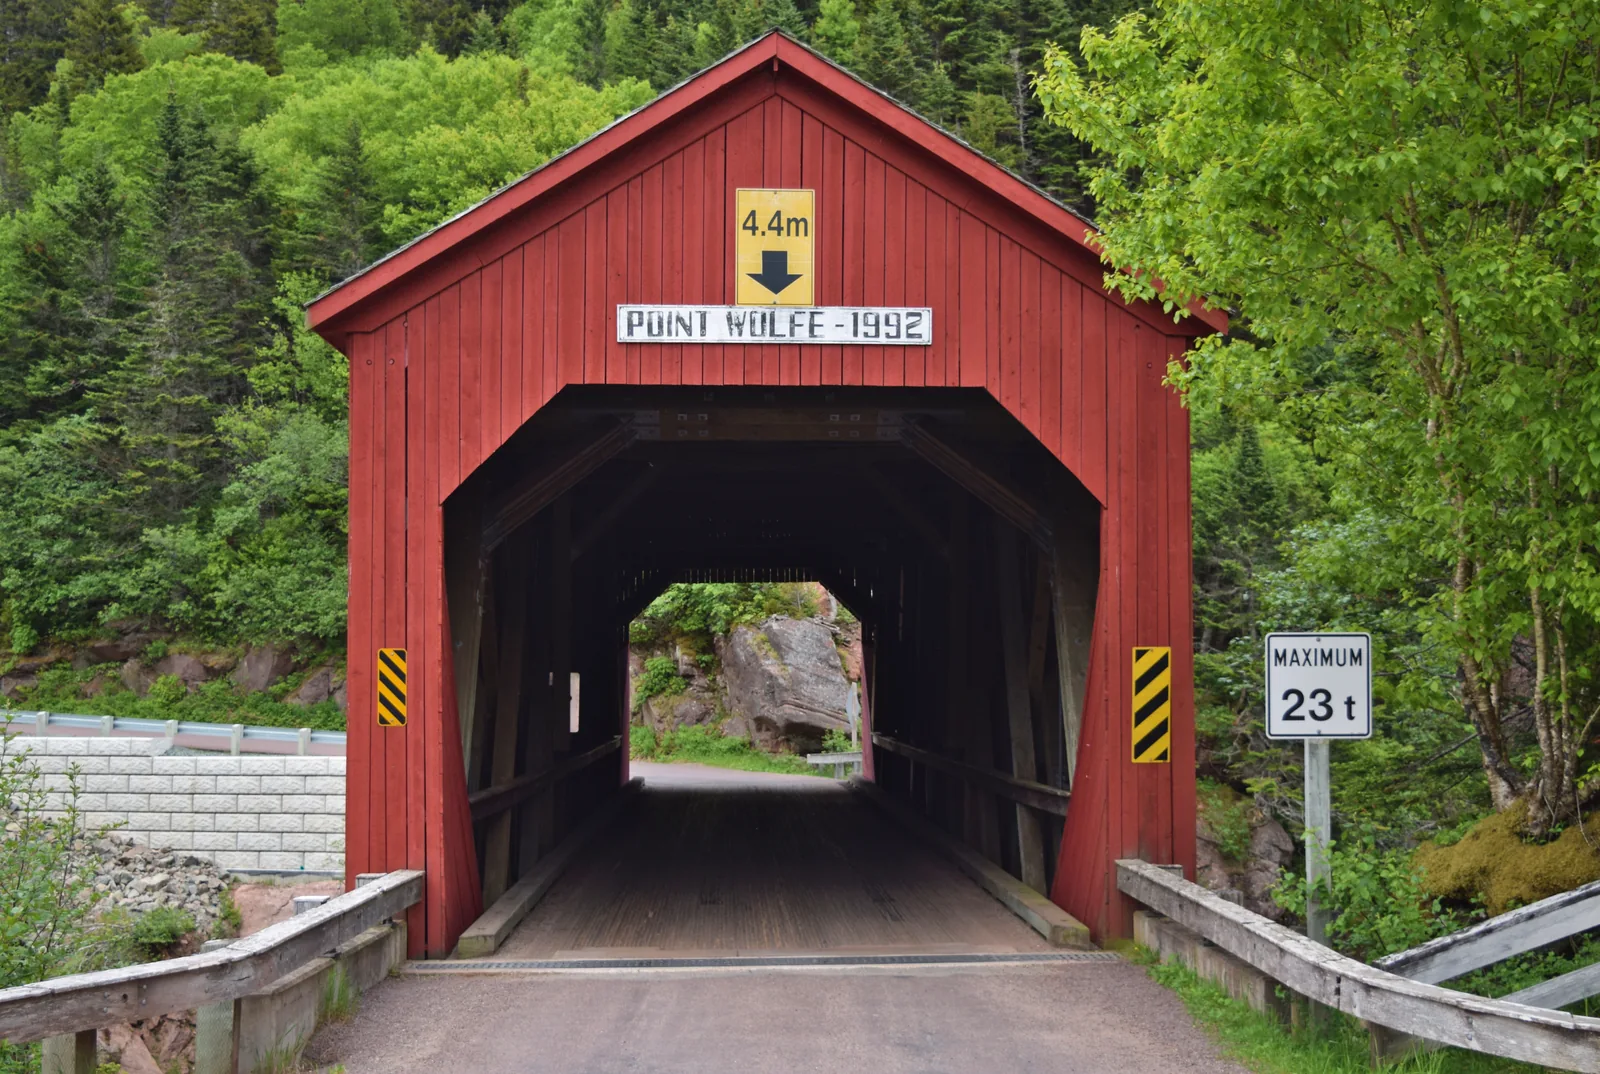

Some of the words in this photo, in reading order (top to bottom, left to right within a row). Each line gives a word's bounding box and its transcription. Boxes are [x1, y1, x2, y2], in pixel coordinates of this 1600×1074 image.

[742, 210, 809, 237] 4.4m
[626, 310, 708, 338] POINT
[726, 310, 825, 338] WOLFE
[1274, 648, 1363, 667] MAXIMUM
[1282, 688, 1333, 722] 23
[1344, 695, 1356, 721] t
